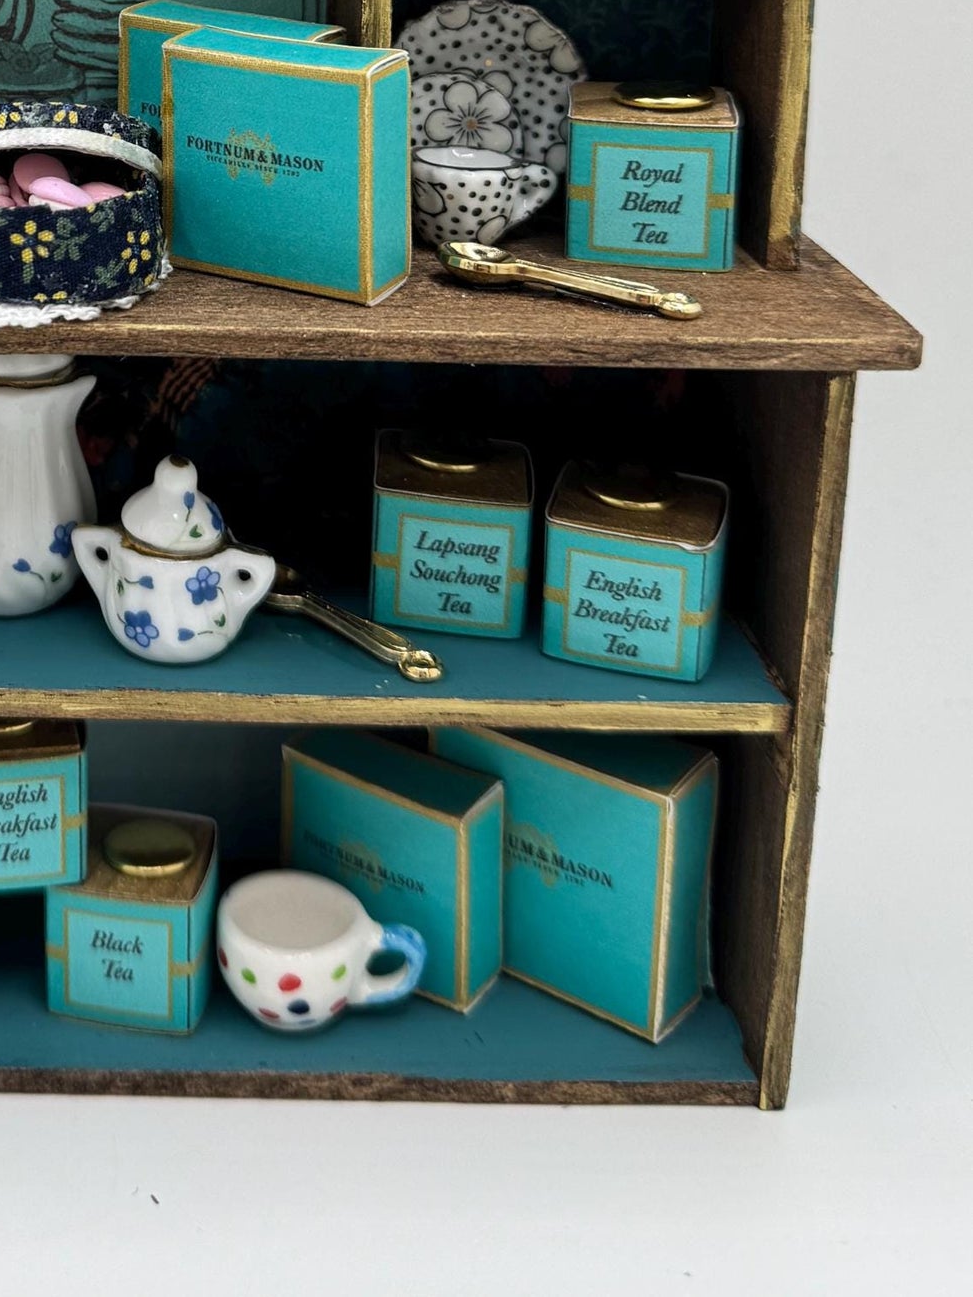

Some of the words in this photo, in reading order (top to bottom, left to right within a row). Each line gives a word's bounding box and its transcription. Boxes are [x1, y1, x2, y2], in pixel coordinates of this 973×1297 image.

[186, 135, 255, 162] FORTNUM
[257, 149, 269, 164] &
[270, 151, 325, 172] MASON
[620, 160, 685, 189] Royal
[618, 190, 684, 215] Blend
[631, 221, 669, 245] Tea
[413, 530, 501, 565] Lapsang
[409, 559, 502, 595] Souchong
[582, 569, 662, 602] English
[437, 591, 472, 615] Tea
[571, 597, 671, 633] Breakfast
[603, 633, 639, 659] Tea
[551, 850, 612, 889] MASON
[90, 929, 143, 955] Black
[101, 959, 134, 983] Tea
